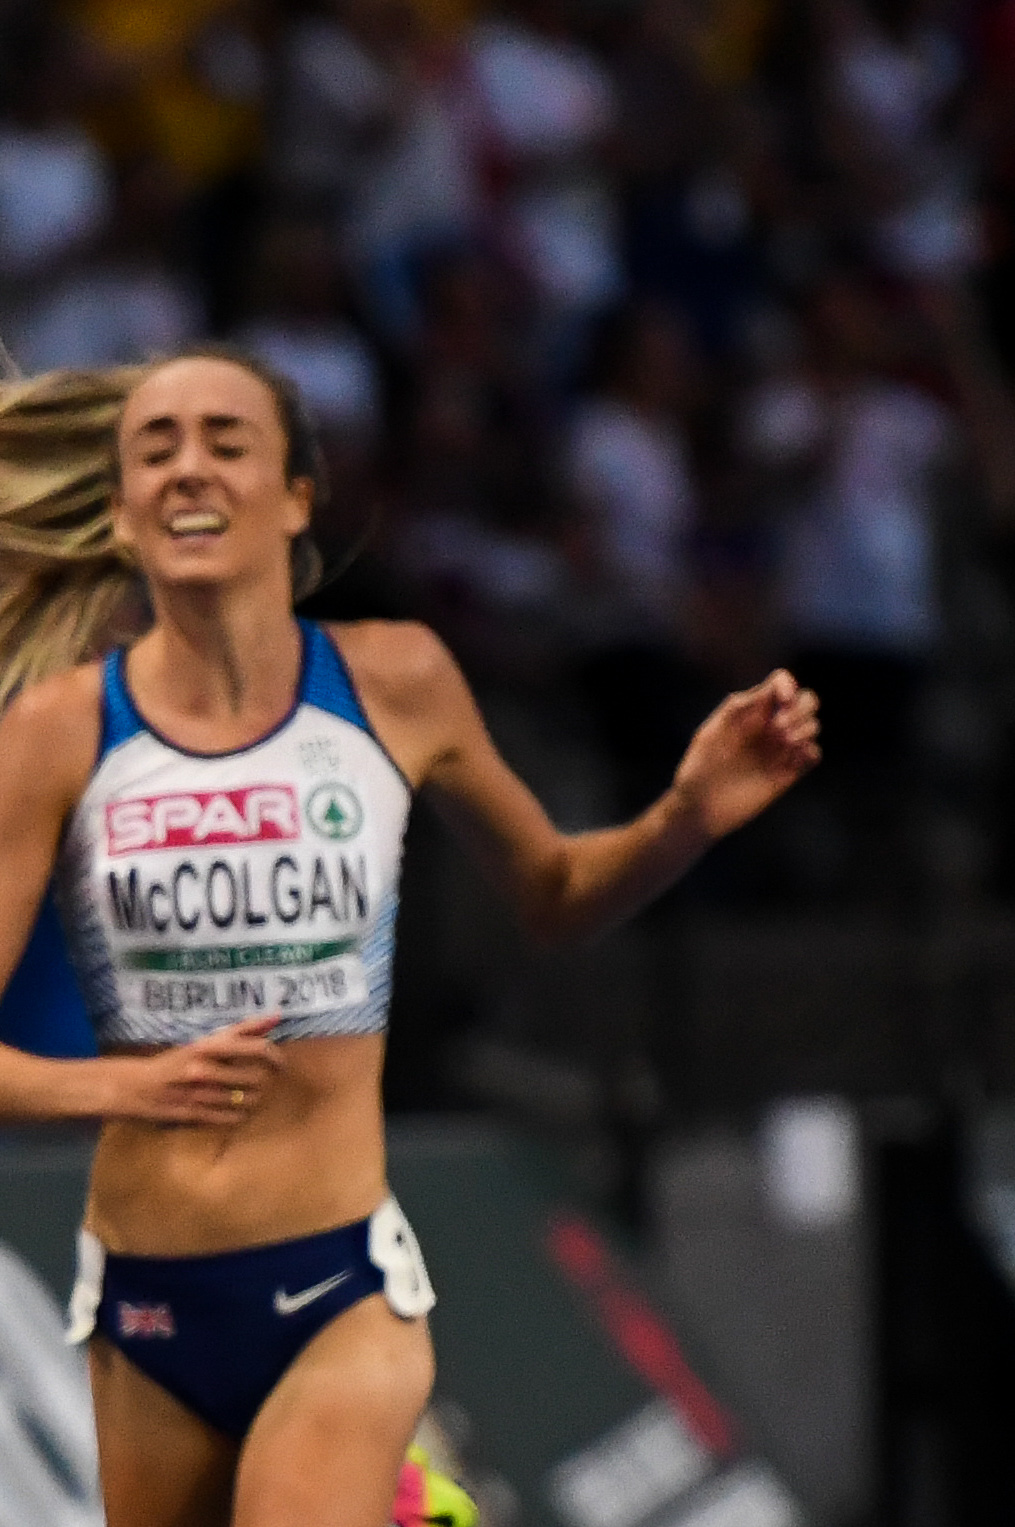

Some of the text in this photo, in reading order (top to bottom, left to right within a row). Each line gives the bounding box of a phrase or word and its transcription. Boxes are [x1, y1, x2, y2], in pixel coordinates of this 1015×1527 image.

[109, 788, 295, 851] SPAR
[108, 855, 369, 932] McCOLGAN
[144, 967, 348, 1011] BERLIN 2018
